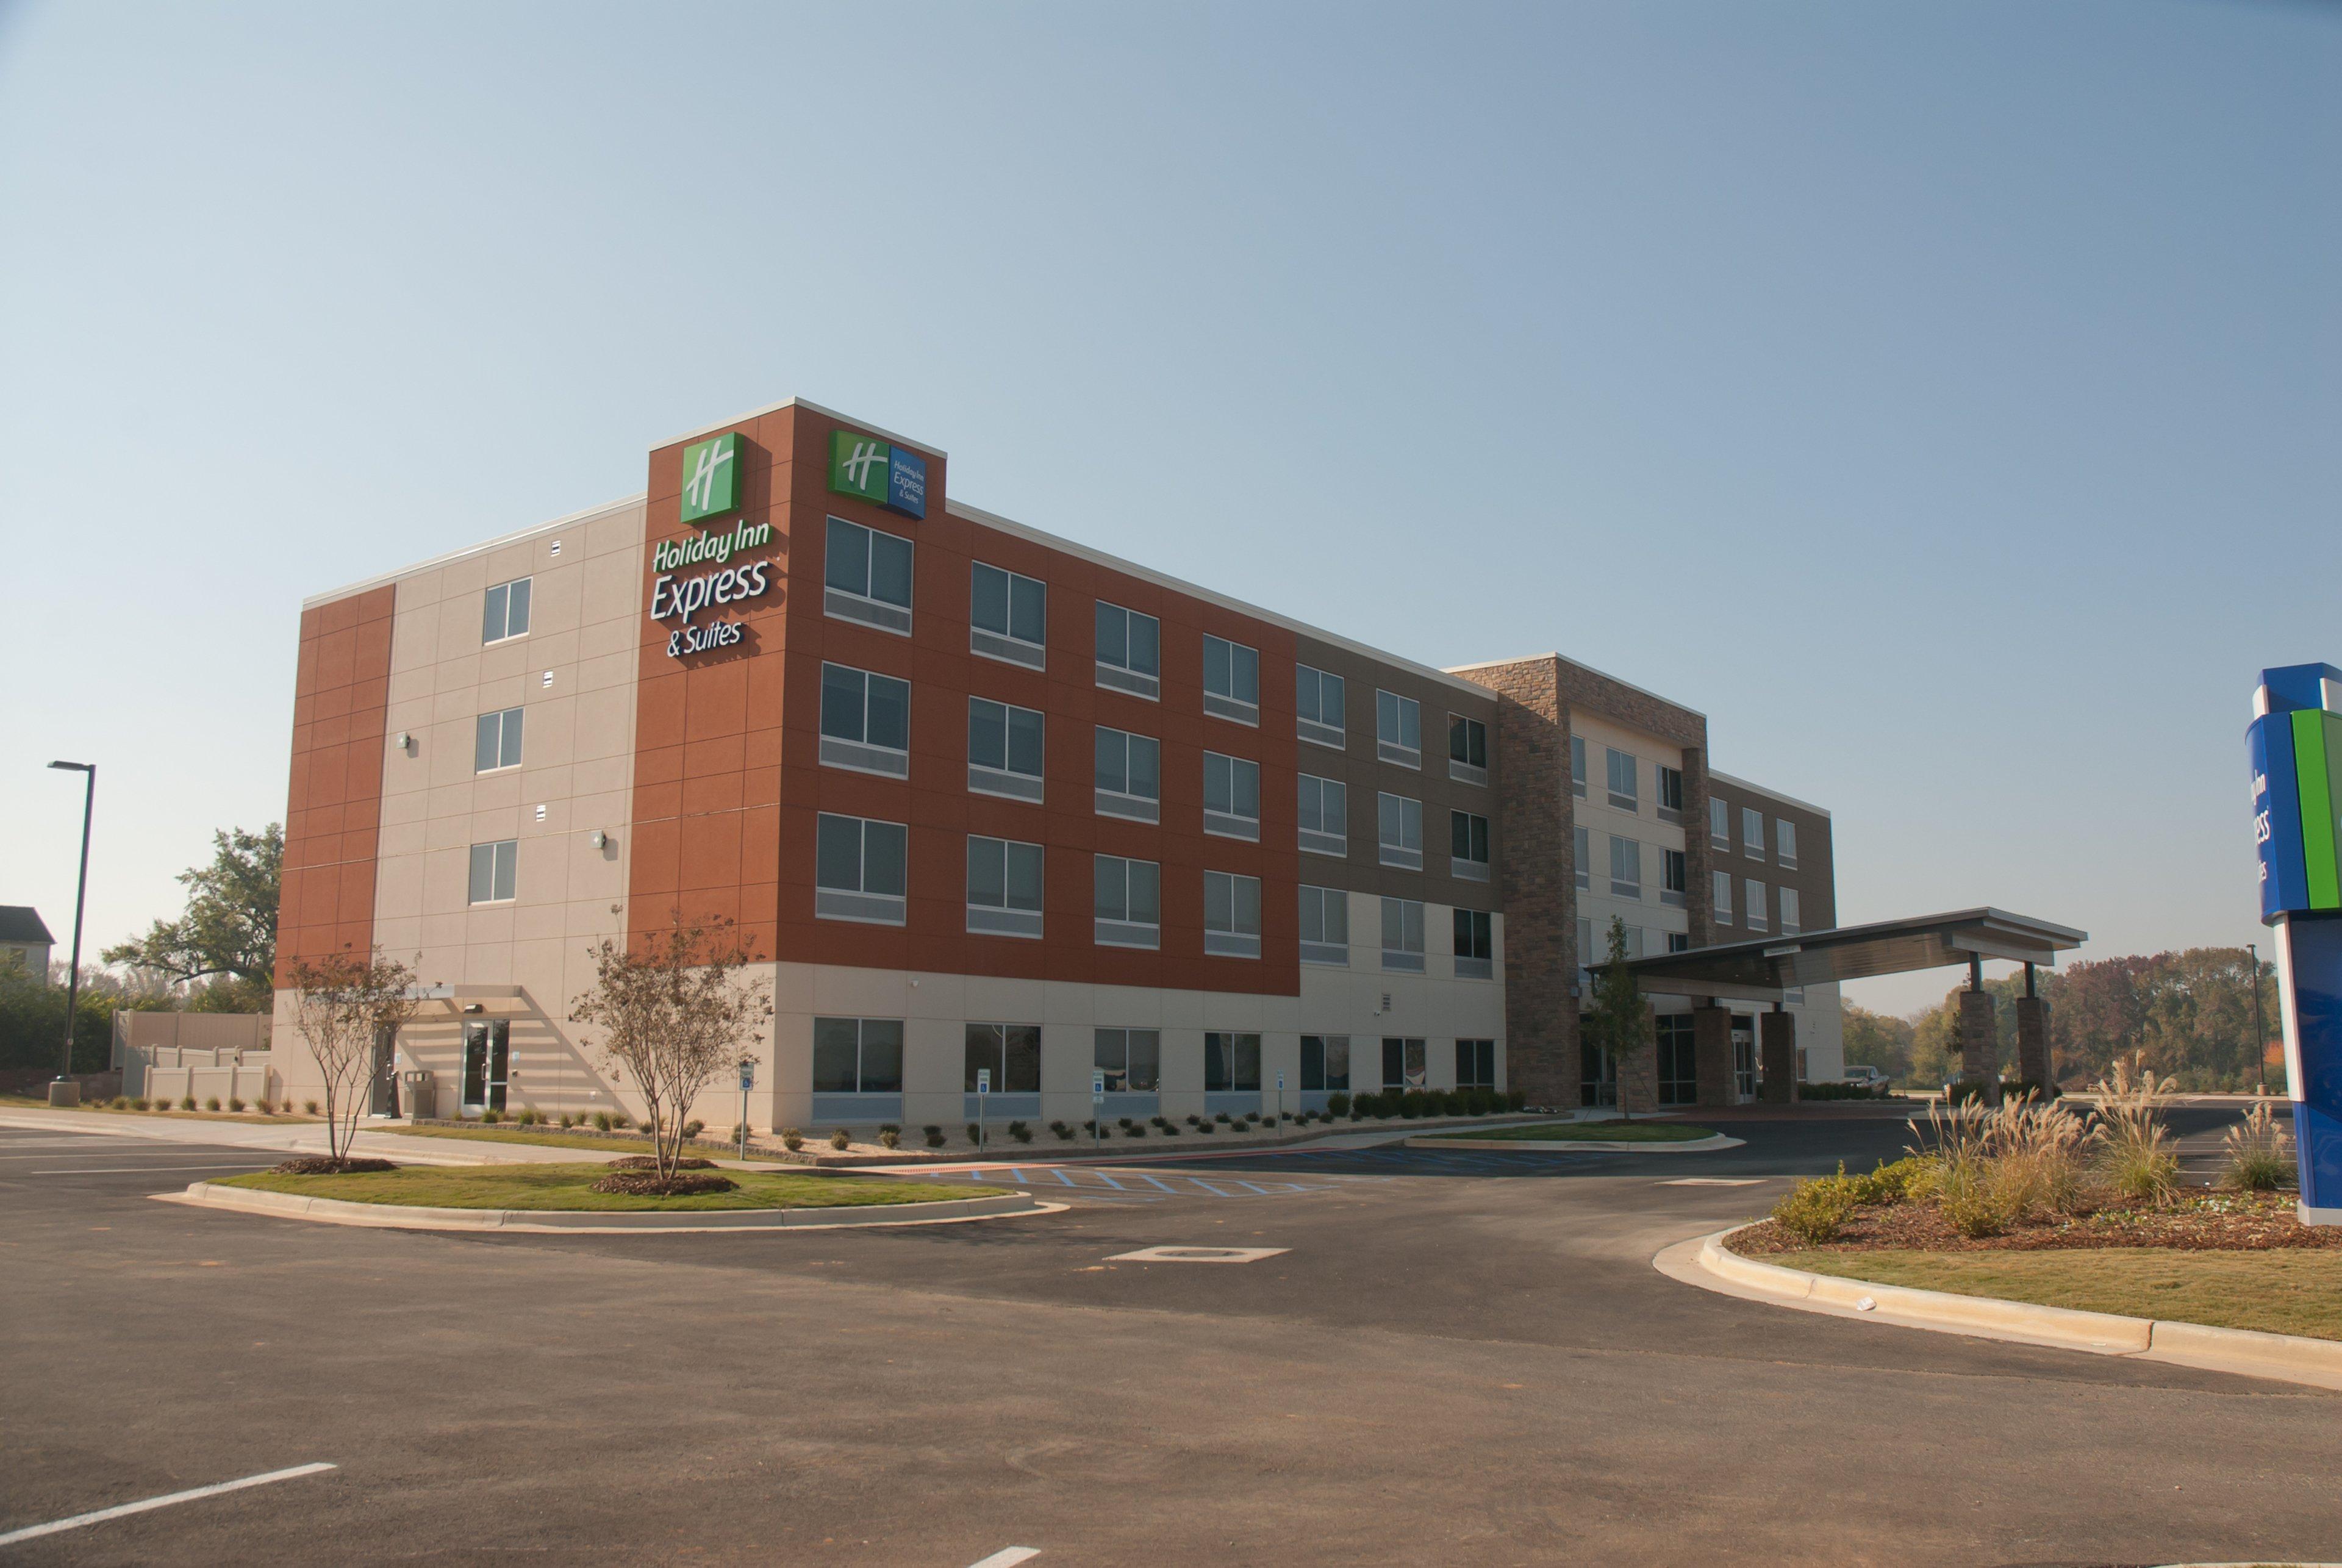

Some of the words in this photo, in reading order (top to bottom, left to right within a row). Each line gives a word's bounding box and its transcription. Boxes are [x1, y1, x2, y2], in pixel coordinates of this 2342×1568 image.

[894, 460, 916, 479] Holiday
[894, 471, 923, 495] Express
[900, 489, 904, 498] &
[904, 491, 919, 504] Suites
[653, 530, 732, 573] Holiday
[734, 519, 770, 551] Inn
[651, 561, 768, 624] Express
[667, 631, 680, 657] &
[684, 621, 742, 654] Suites
